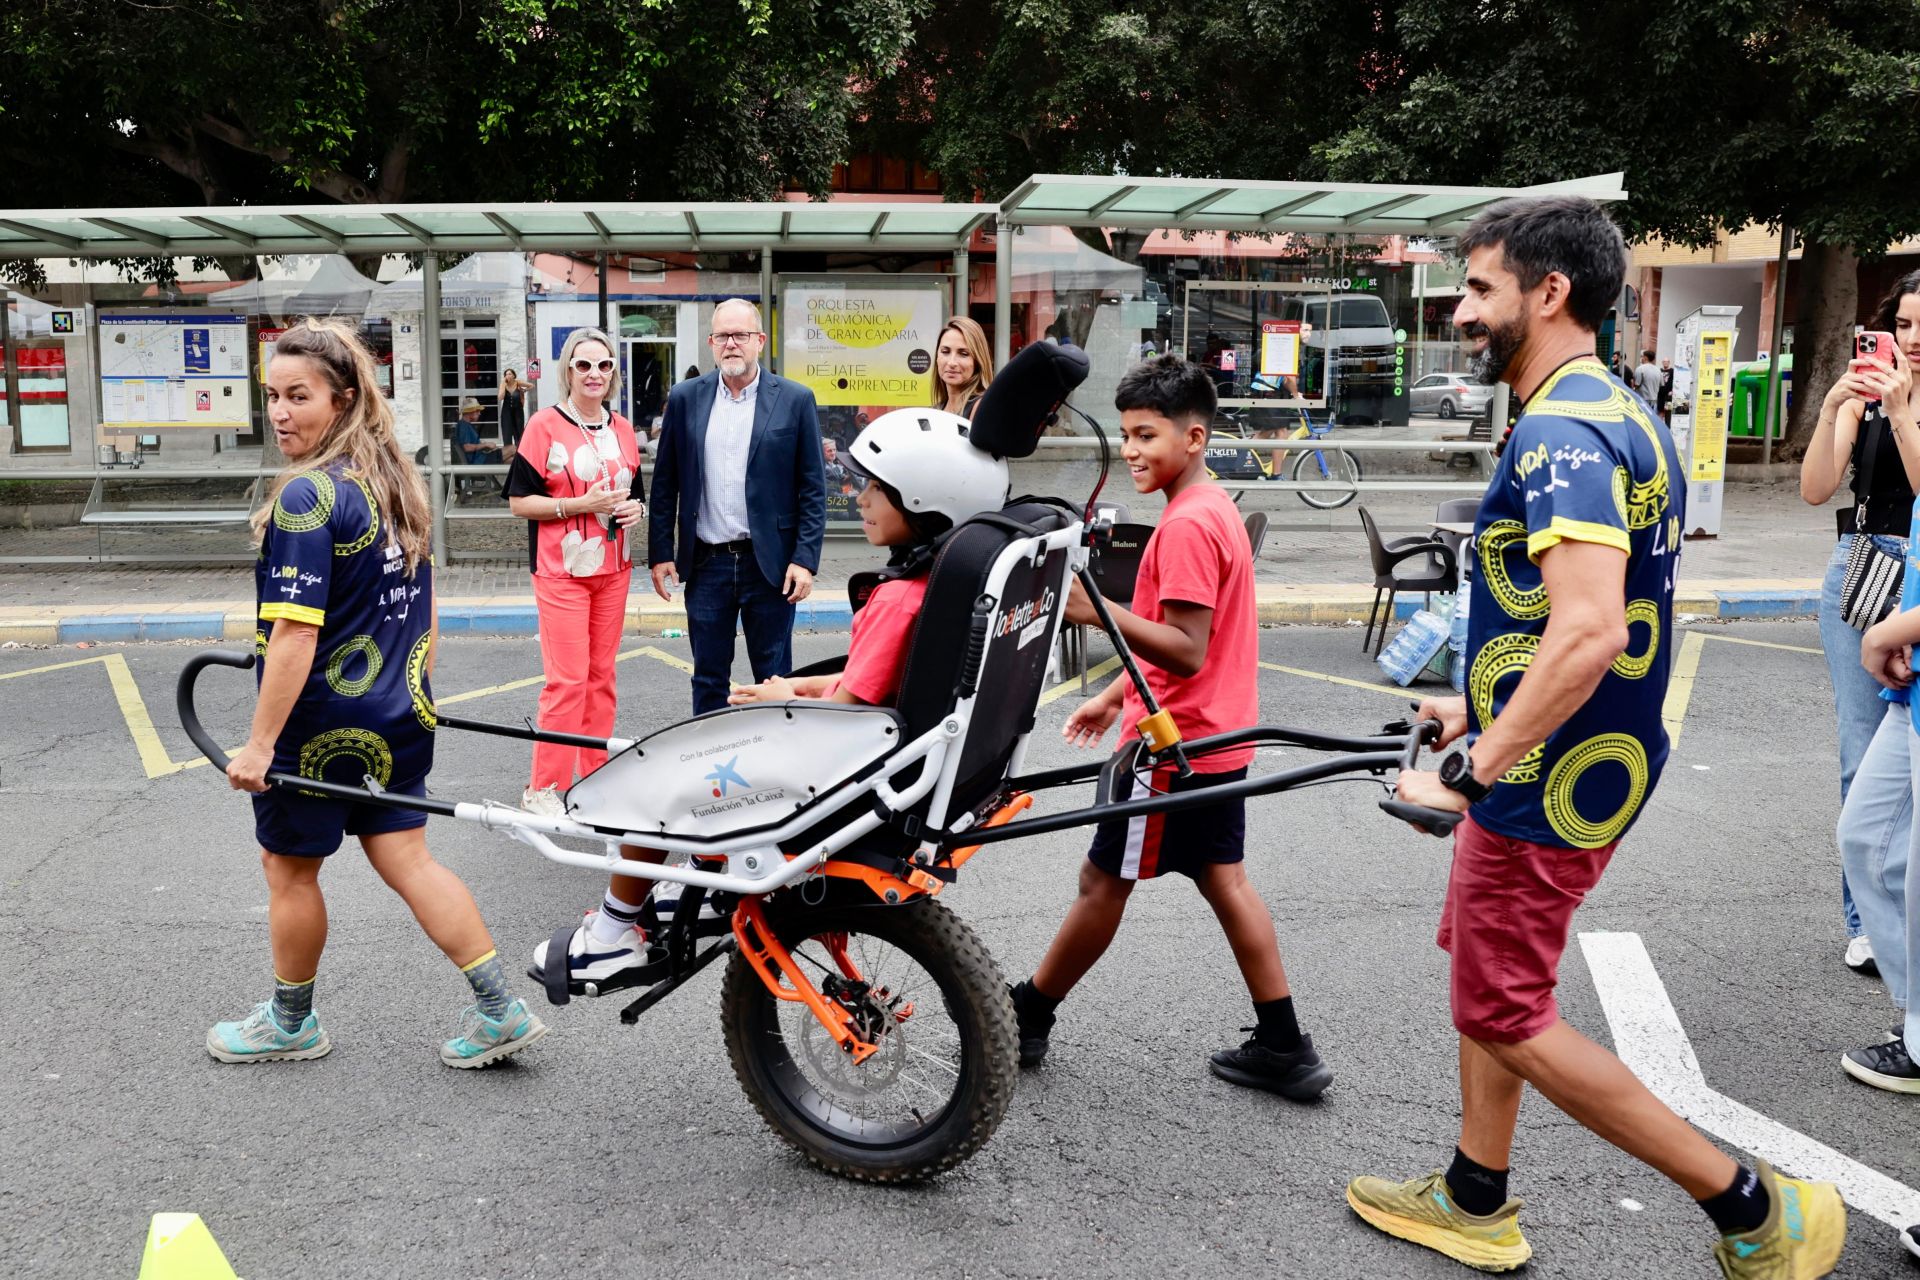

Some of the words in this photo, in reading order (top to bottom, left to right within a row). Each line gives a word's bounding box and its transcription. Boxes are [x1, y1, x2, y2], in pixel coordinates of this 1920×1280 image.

[440, 297, 471, 307] FONSO
[475, 297, 491, 307] XIII
[807, 299, 875, 312] ORQUESTA
[807, 311, 892, 326] FILARMÓNICA
[807, 329, 824, 340] DE
[827, 329, 861, 340] GRAN
[865, 329, 919, 341] CANARIA
[806, 361, 867, 376] DÉJATE
[1553, 445, 1601, 469] sigue
[827, 496, 849, 506] 5/26
[680, 753, 695, 762] Con
[696, 750, 703, 758] la
[704, 738, 752, 756] colaboración
[753, 735, 765, 744] de:
[691, 800, 742, 818] Fundación
